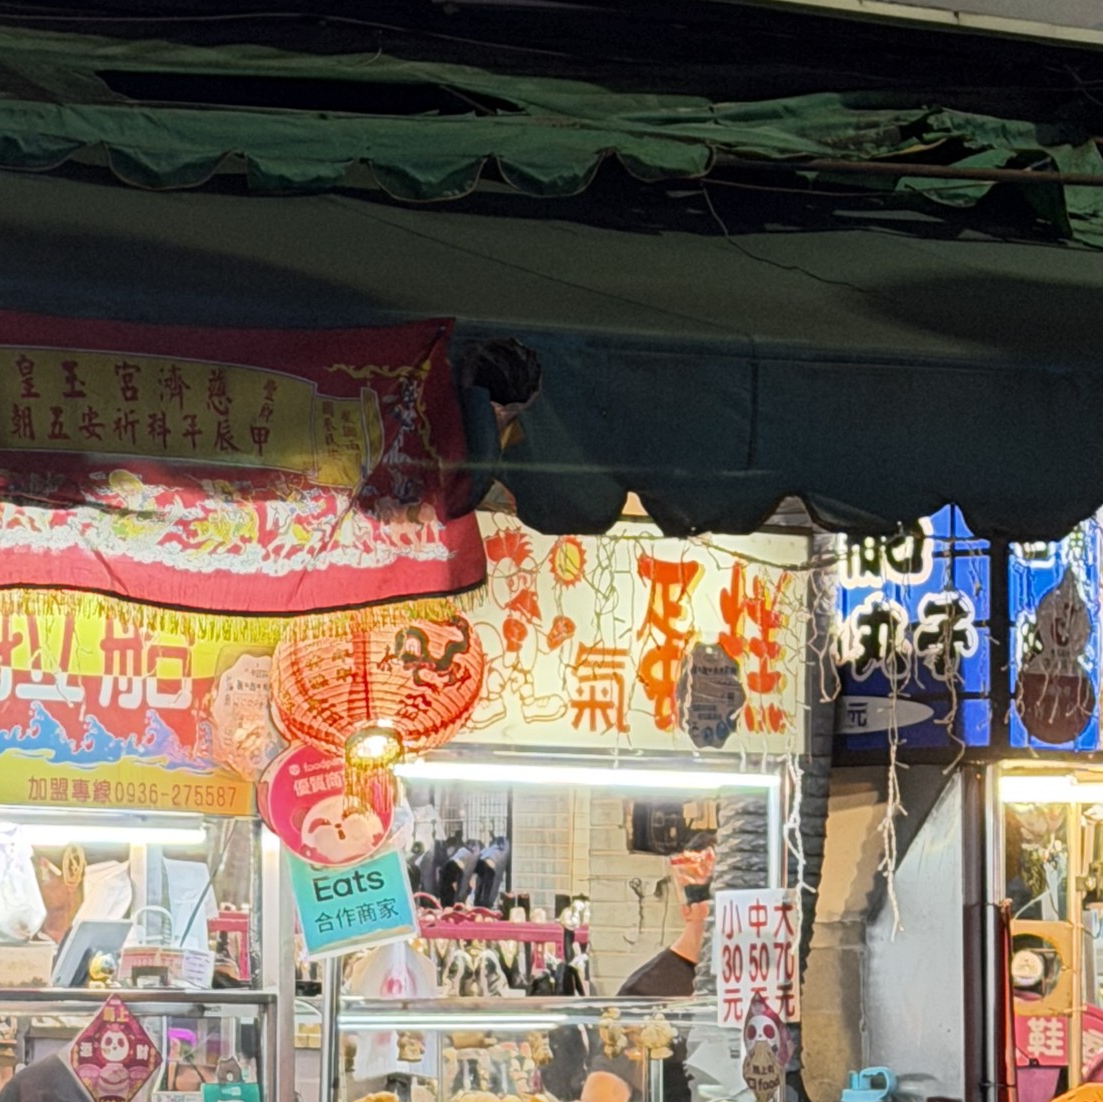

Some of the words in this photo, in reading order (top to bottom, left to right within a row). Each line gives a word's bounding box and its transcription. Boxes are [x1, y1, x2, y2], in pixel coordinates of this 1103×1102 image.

[312, 868, 386, 904] Eats
[315, 898, 401, 935] 合作商家
[721, 899, 743, 940] 小
[748, 897, 768, 939] 中
[773, 902, 795, 940] 大
[721, 943, 744, 985] 30
[748, 941, 771, 983] 50
[773, 940, 796, 982] 70
[722, 987, 744, 1023] 元
[774, 982, 796, 1019] 元
[1026, 1016, 1065, 1058] 鞋
